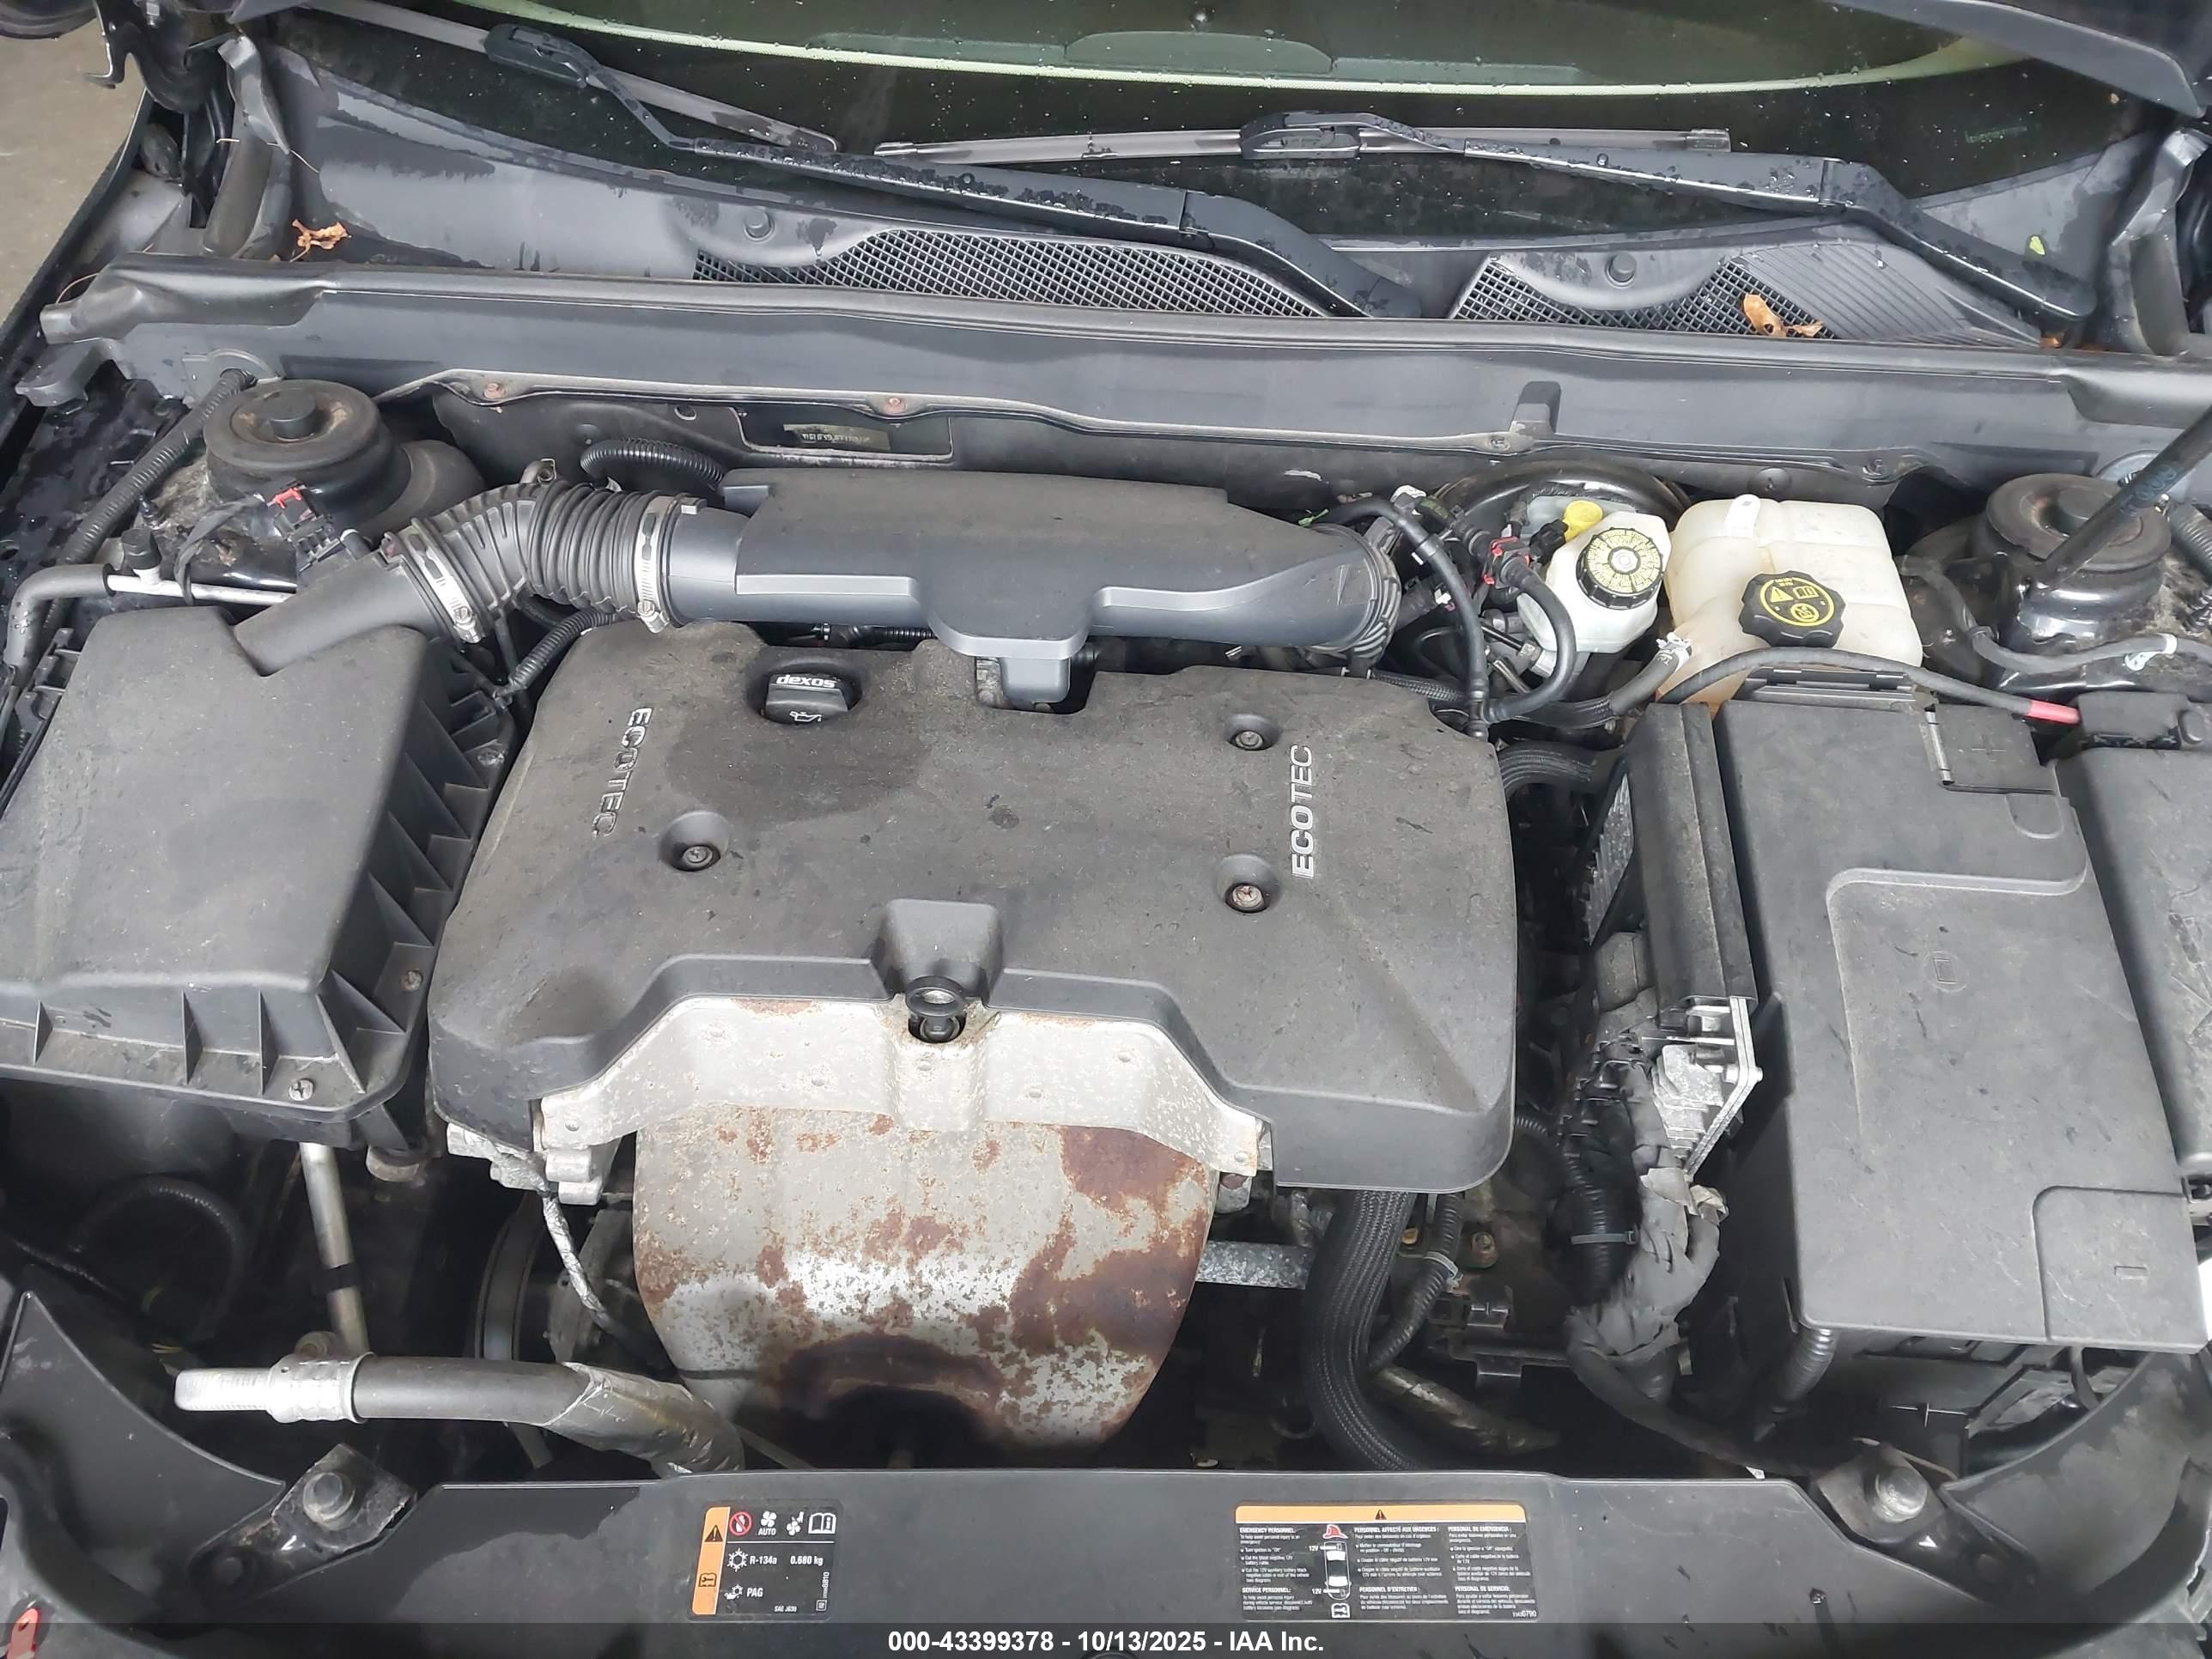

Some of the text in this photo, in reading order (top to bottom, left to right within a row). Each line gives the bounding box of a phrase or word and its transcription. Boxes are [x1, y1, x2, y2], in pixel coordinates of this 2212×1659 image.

[776, 674, 836, 688] dexos
[592, 708, 653, 838] ECOTEC
[1291, 744, 1314, 878] ECOTEC
[750, 1556, 777, 1565] R-134a
[813, 1556, 823, 1566] kg
[747, 1587, 763, 1597] PAG
